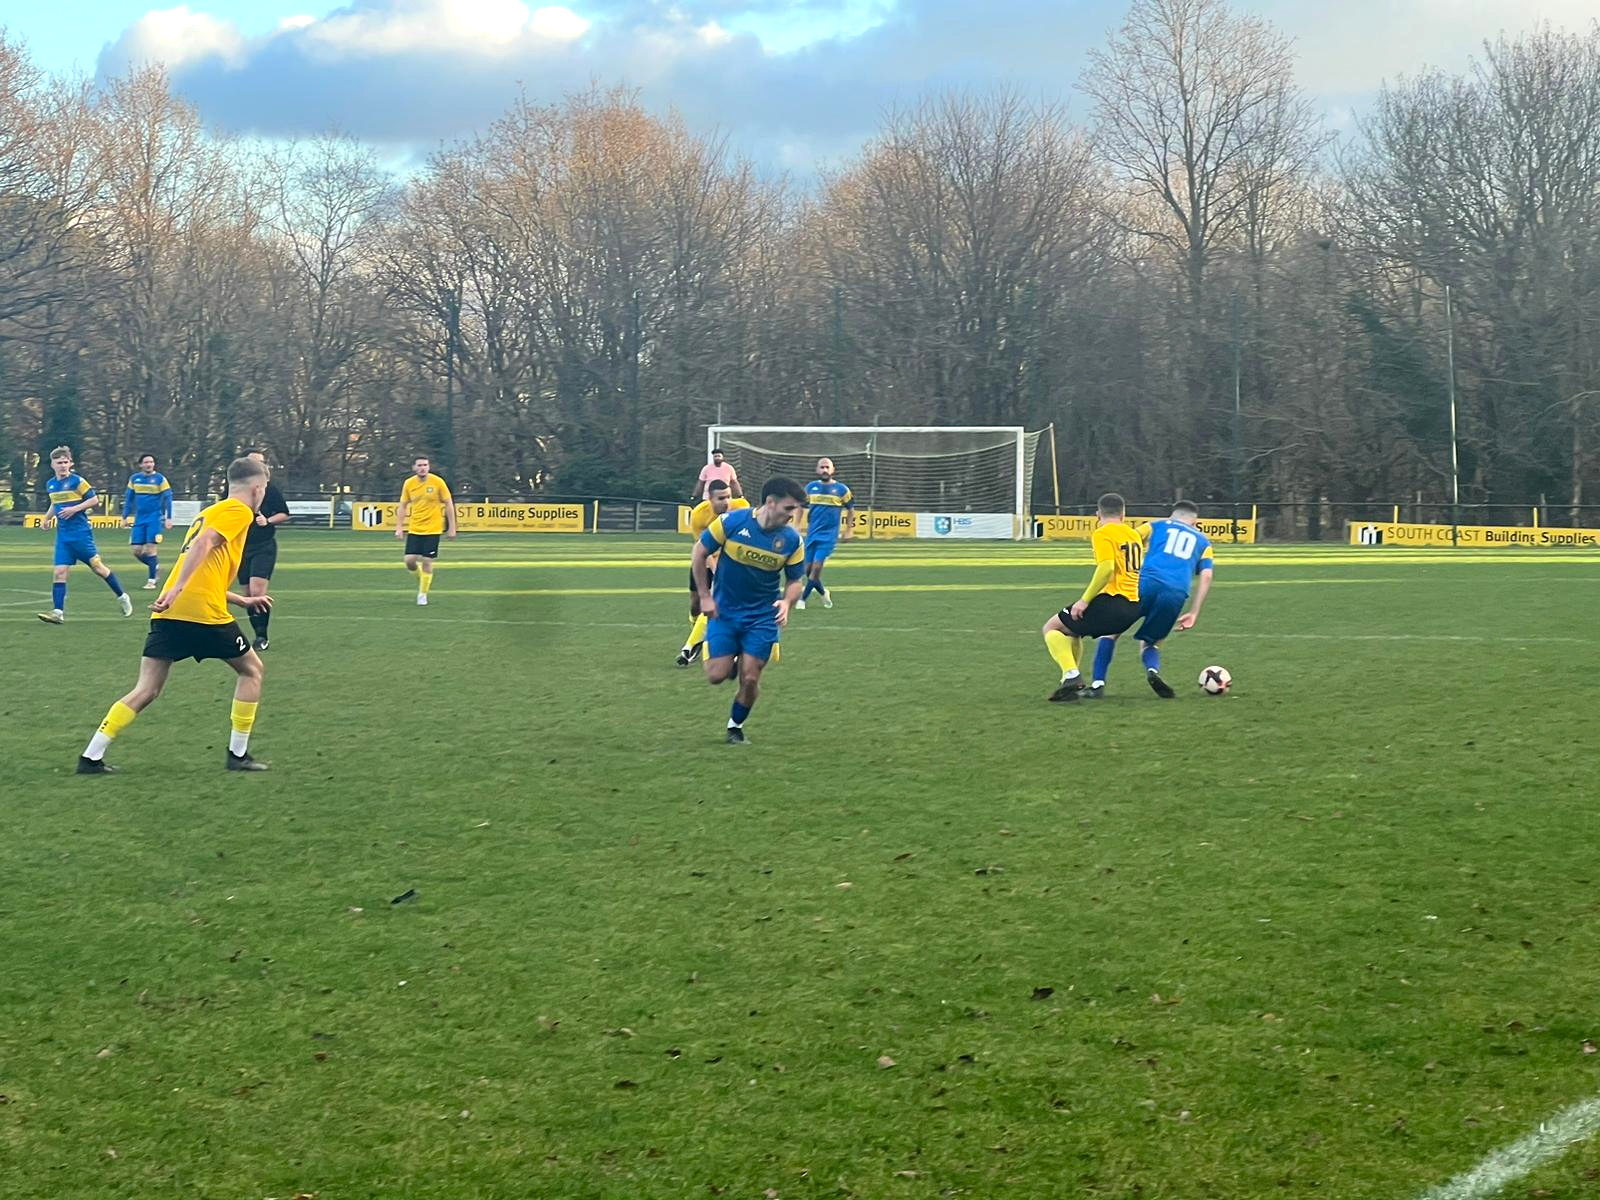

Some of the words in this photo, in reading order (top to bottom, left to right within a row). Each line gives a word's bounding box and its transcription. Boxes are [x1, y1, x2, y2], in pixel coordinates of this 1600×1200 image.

[528, 507, 578, 520] Supplies
[859, 514, 911, 528] Spplies
[1048, 518, 1091, 531] SOUTH
[1387, 526, 1433, 540] SOUTH
[1541, 531, 1596, 544] Supplies
[1163, 528, 1197, 560] 10
[1120, 541, 1142, 573] 10
[236, 636, 247, 651] 2
